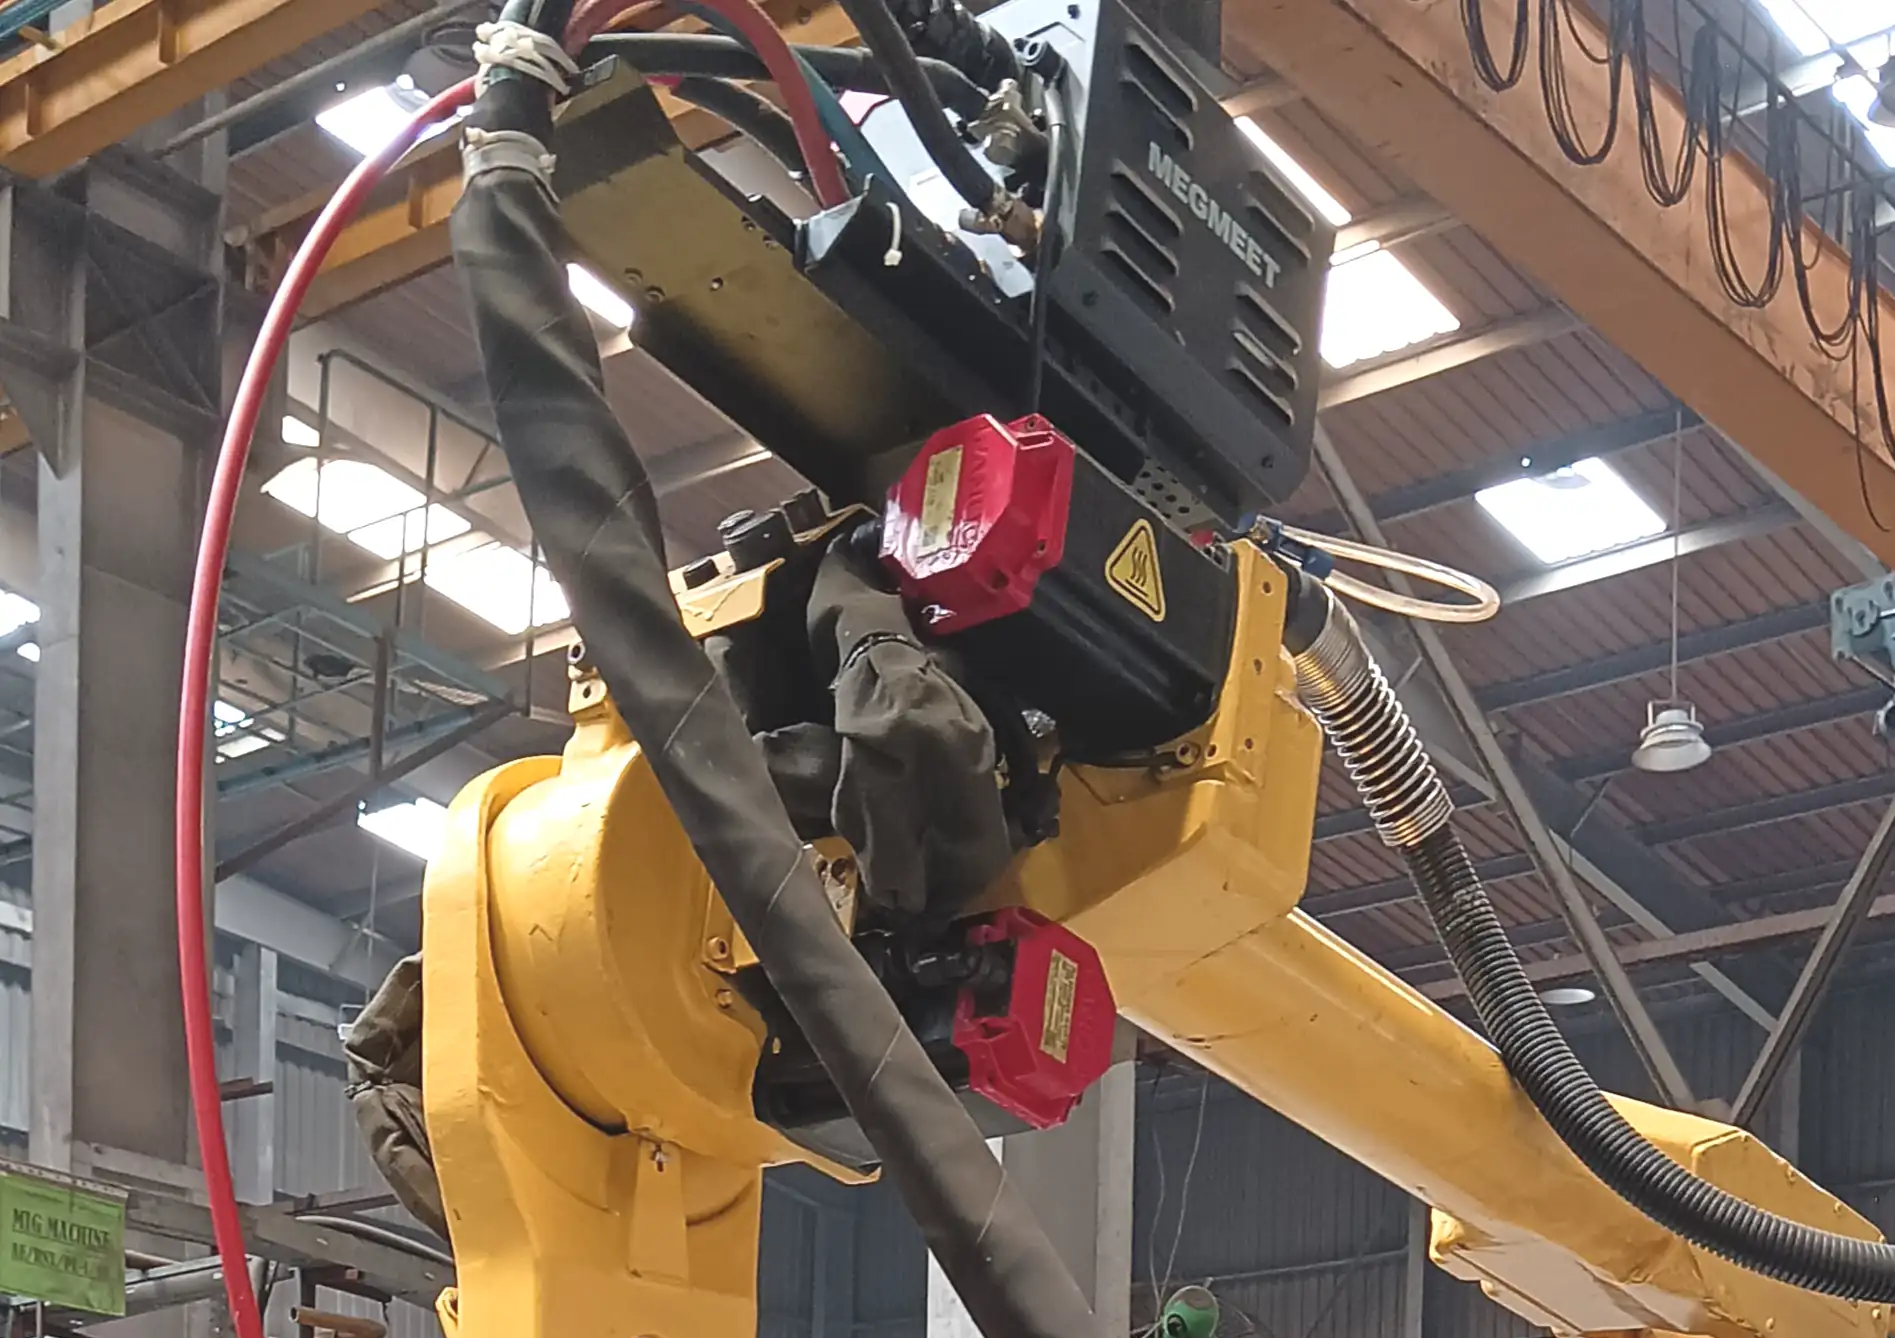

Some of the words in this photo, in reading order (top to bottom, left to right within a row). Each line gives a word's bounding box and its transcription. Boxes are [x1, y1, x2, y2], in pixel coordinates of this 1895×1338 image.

[1148, 141, 1281, 288] MEGMEET
[12, 1208, 43, 1234] MIG
[48, 1217, 110, 1247] MACHINE
